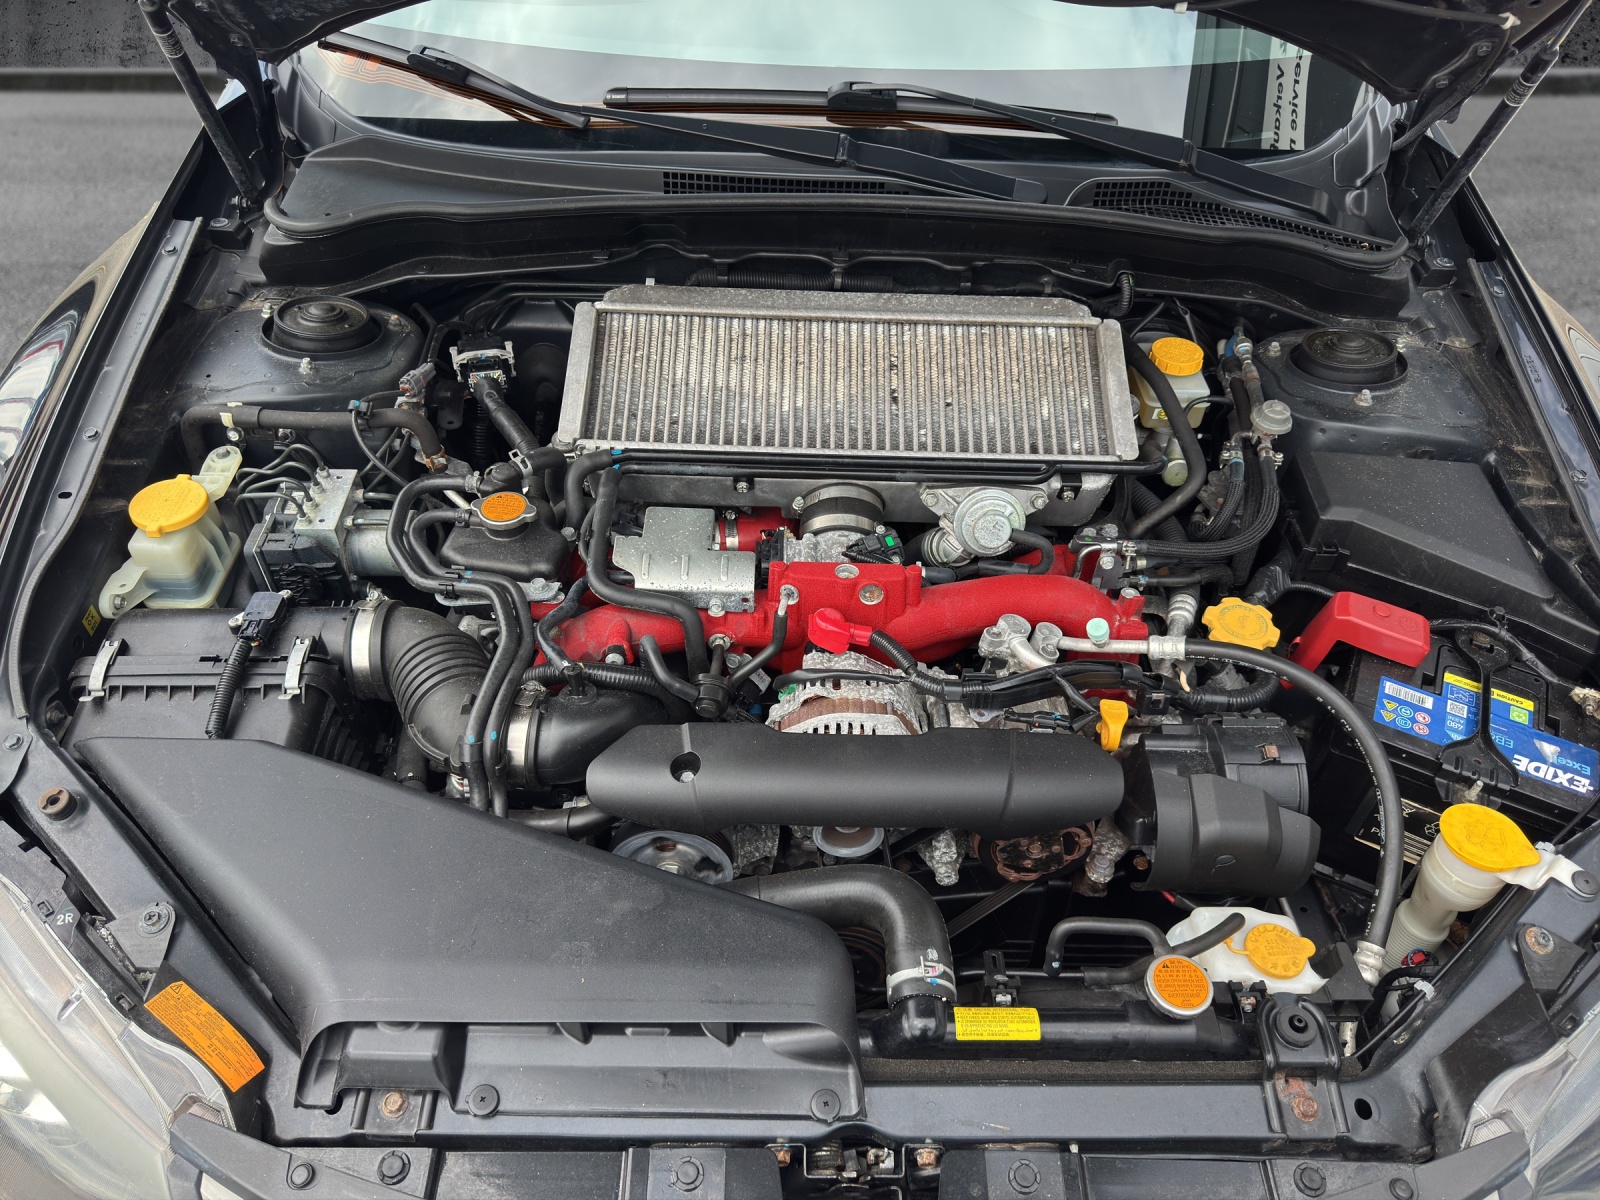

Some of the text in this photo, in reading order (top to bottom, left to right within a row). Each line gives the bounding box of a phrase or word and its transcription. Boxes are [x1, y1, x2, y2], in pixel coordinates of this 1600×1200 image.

[1496, 692, 1524, 705] CAUTION
[1446, 720, 1464, 731] 480
[1512, 754, 1594, 794] EXIDE
[56, 912, 74, 925] 2R
